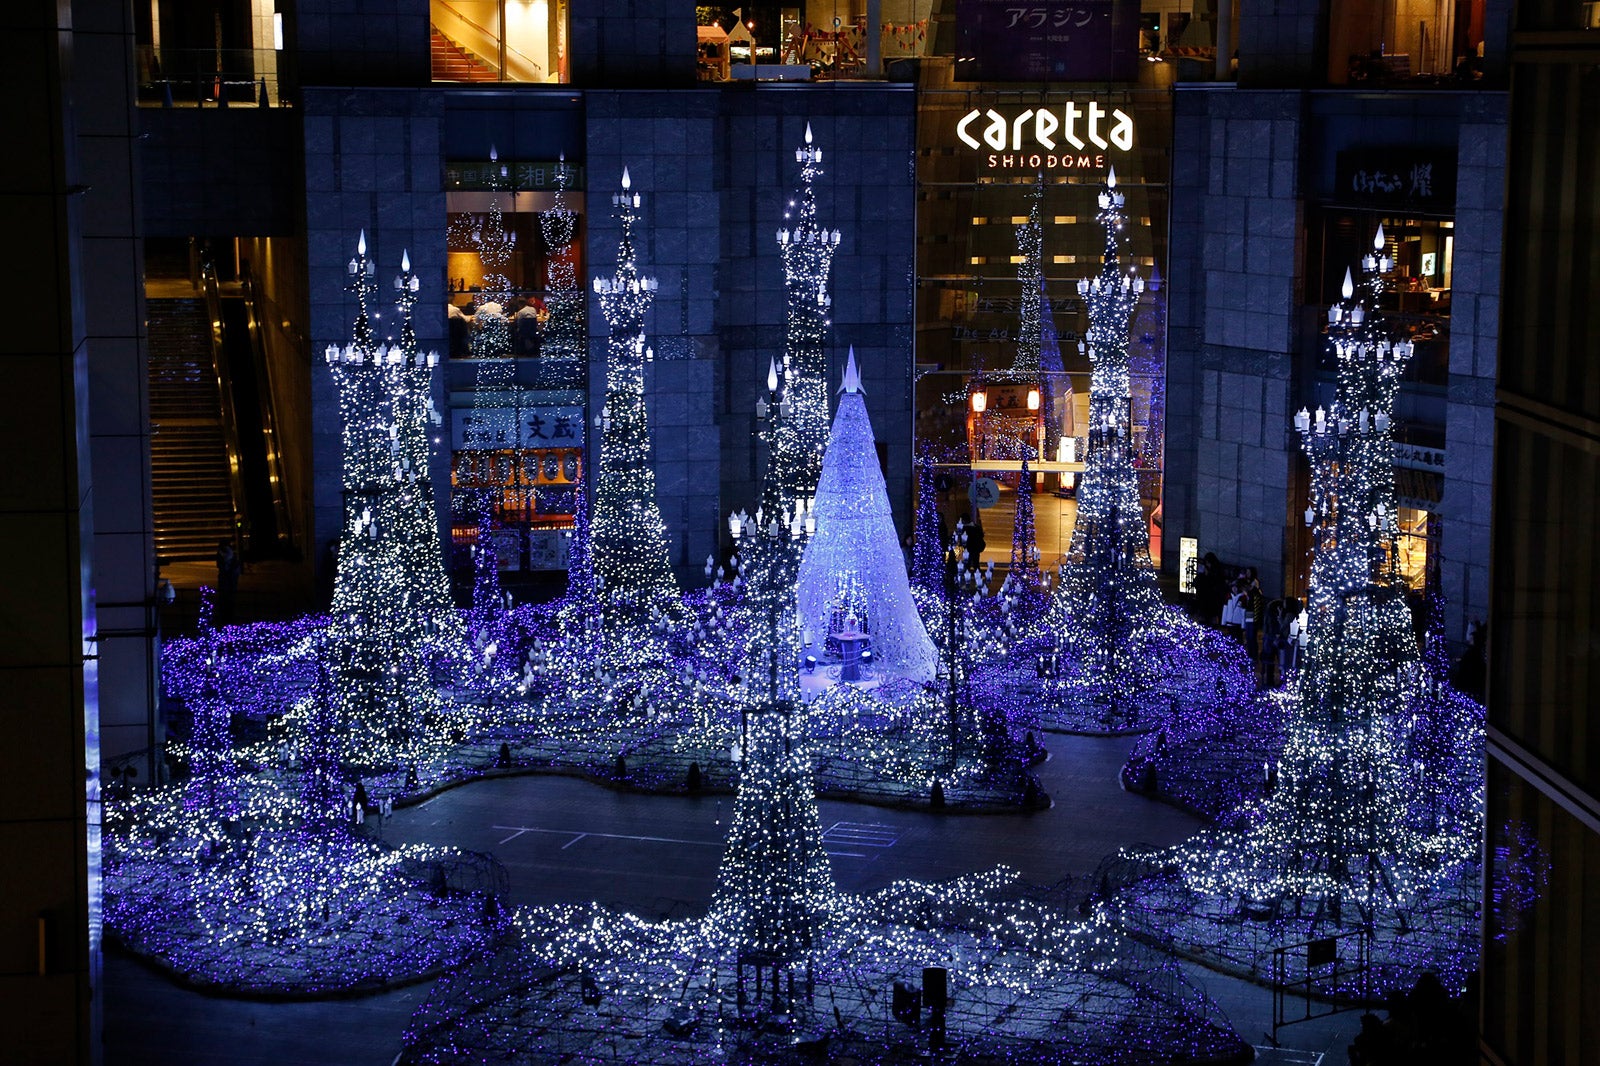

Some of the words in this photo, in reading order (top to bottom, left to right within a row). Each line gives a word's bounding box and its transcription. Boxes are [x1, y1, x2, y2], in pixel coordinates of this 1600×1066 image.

[1005, 7, 1094, 29] アラジン
[956, 100, 1134, 151] caretta
[988, 154, 1106, 168] SHIODOME
[526, 414, 578, 440] 文蔵
